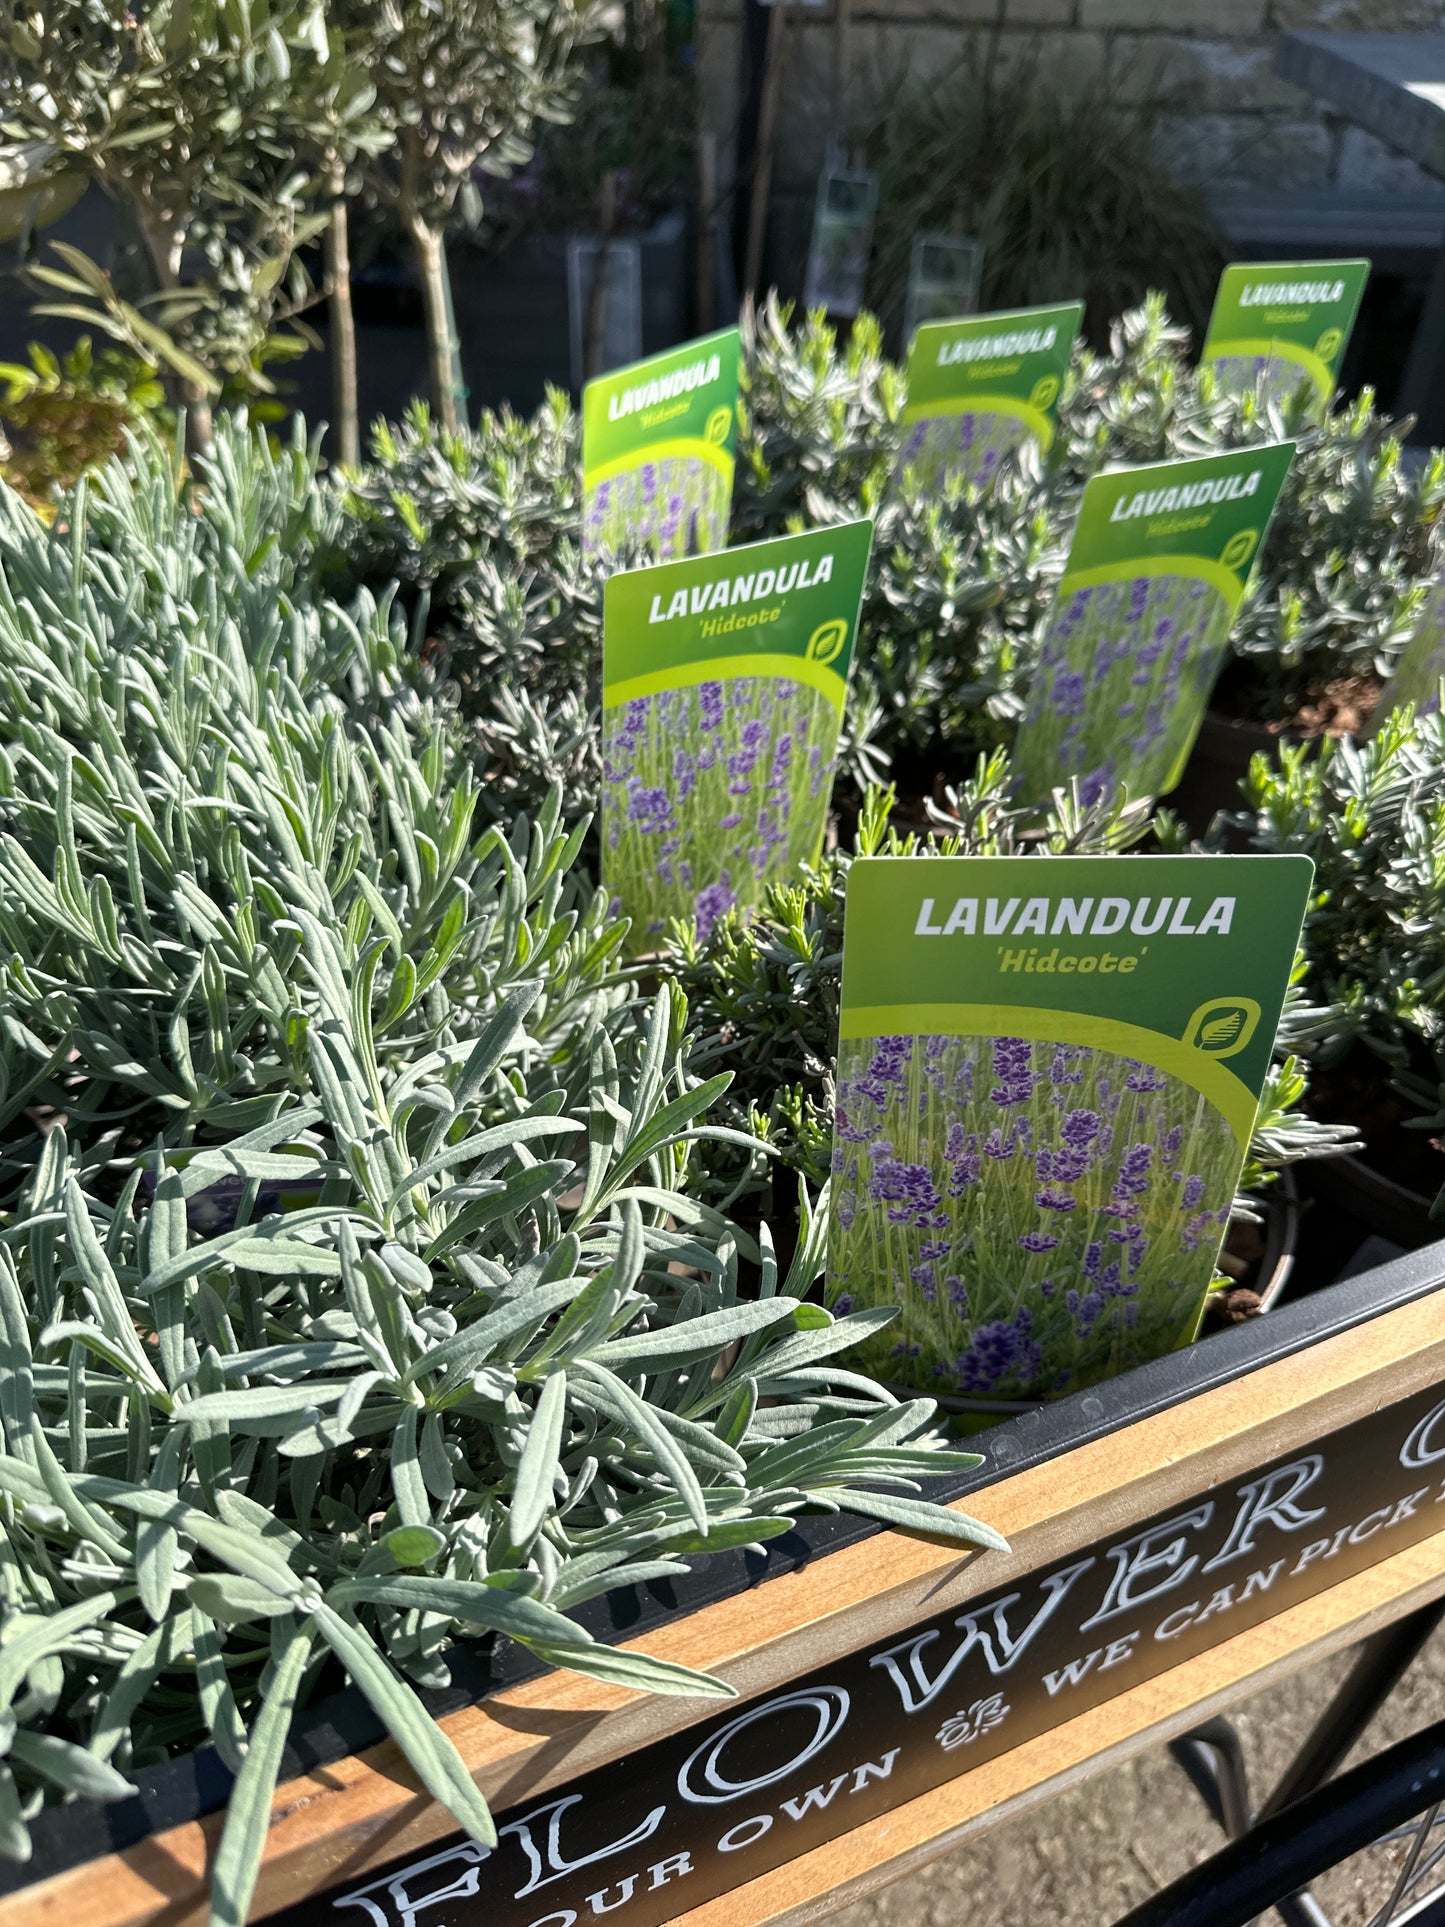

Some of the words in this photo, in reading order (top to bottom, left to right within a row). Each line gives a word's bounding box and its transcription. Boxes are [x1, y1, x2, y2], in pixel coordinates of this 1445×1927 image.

[608, 354, 720, 422] LAVANDULA
[1109, 469, 1263, 523] LAVANDULA
[648, 554, 834, 624] LAVANDULA
[699, 600, 786, 639] 'Hidcote'
[914, 897, 1236, 935] LAVANDULA
[998, 947, 1148, 973] 'Hidcote'
[717, 1747, 901, 1852] OWN
[1042, 1630, 1141, 1696] WE
[1154, 1558, 1287, 1641] CAN
[1289, 1486, 1430, 1576] PICK
